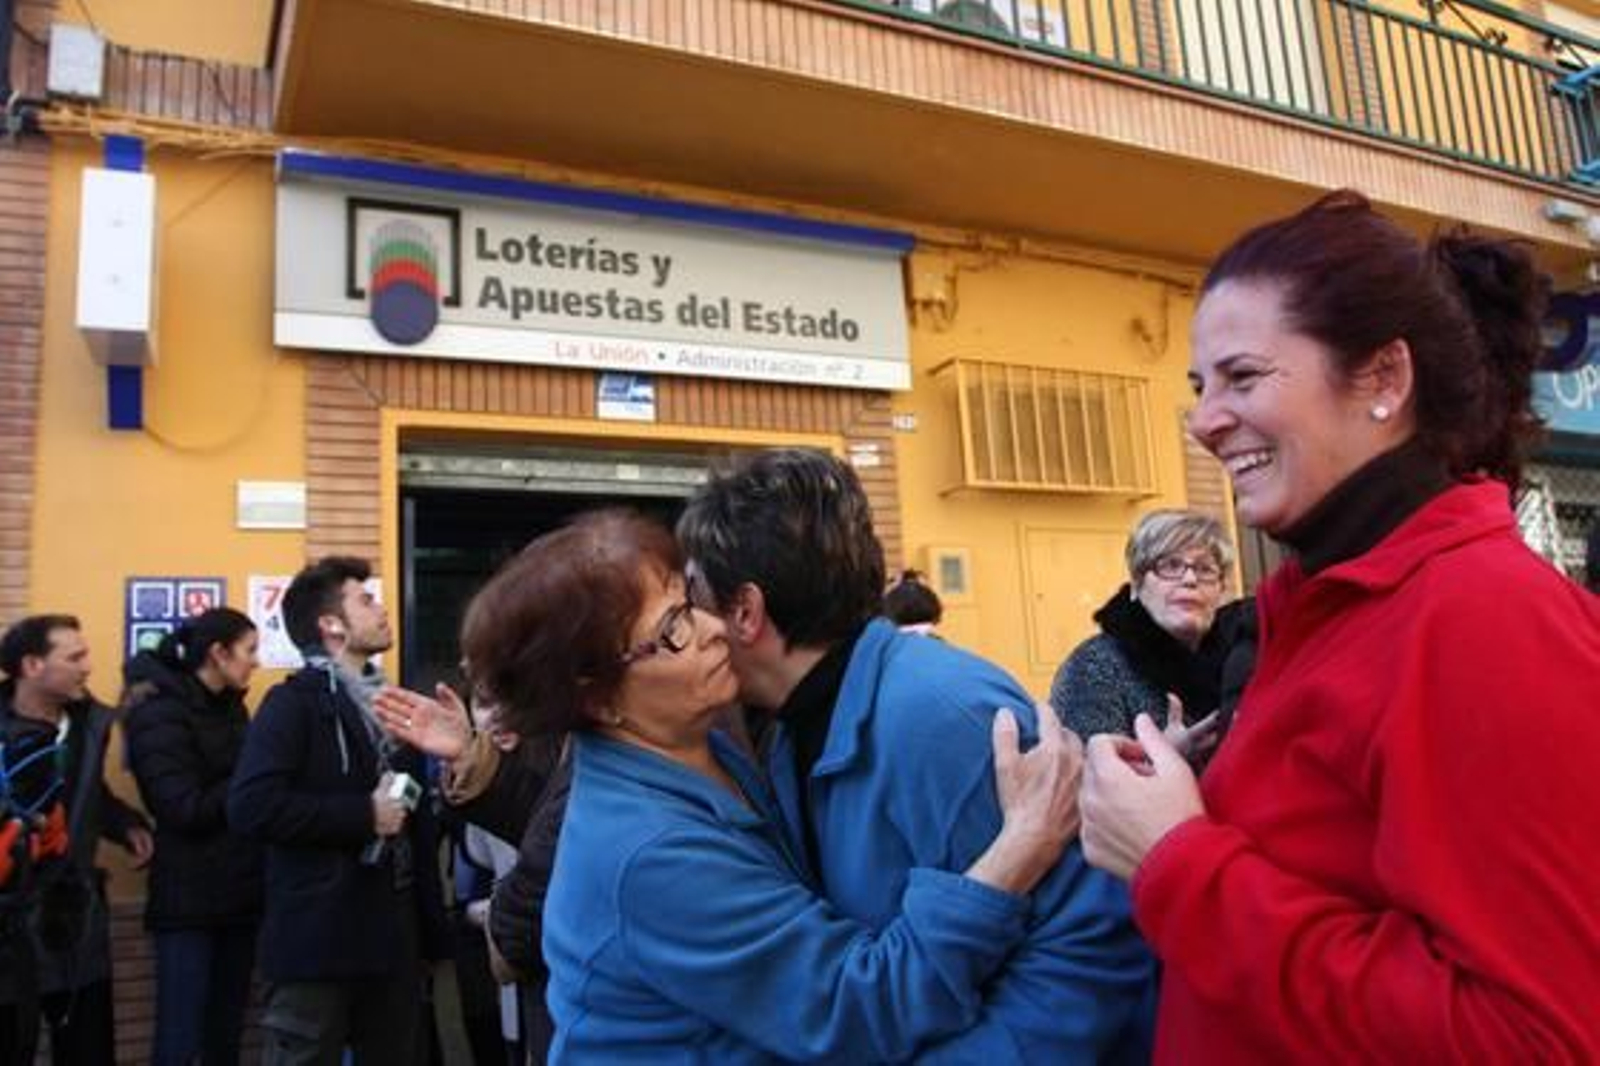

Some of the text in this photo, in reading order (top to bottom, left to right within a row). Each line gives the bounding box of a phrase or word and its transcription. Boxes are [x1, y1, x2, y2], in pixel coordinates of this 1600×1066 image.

[475, 227, 672, 288] Loterías y
[478, 275, 860, 342] Apuestas del Estado
[555, 341, 580, 359] La
[589, 341, 650, 366] Unión
